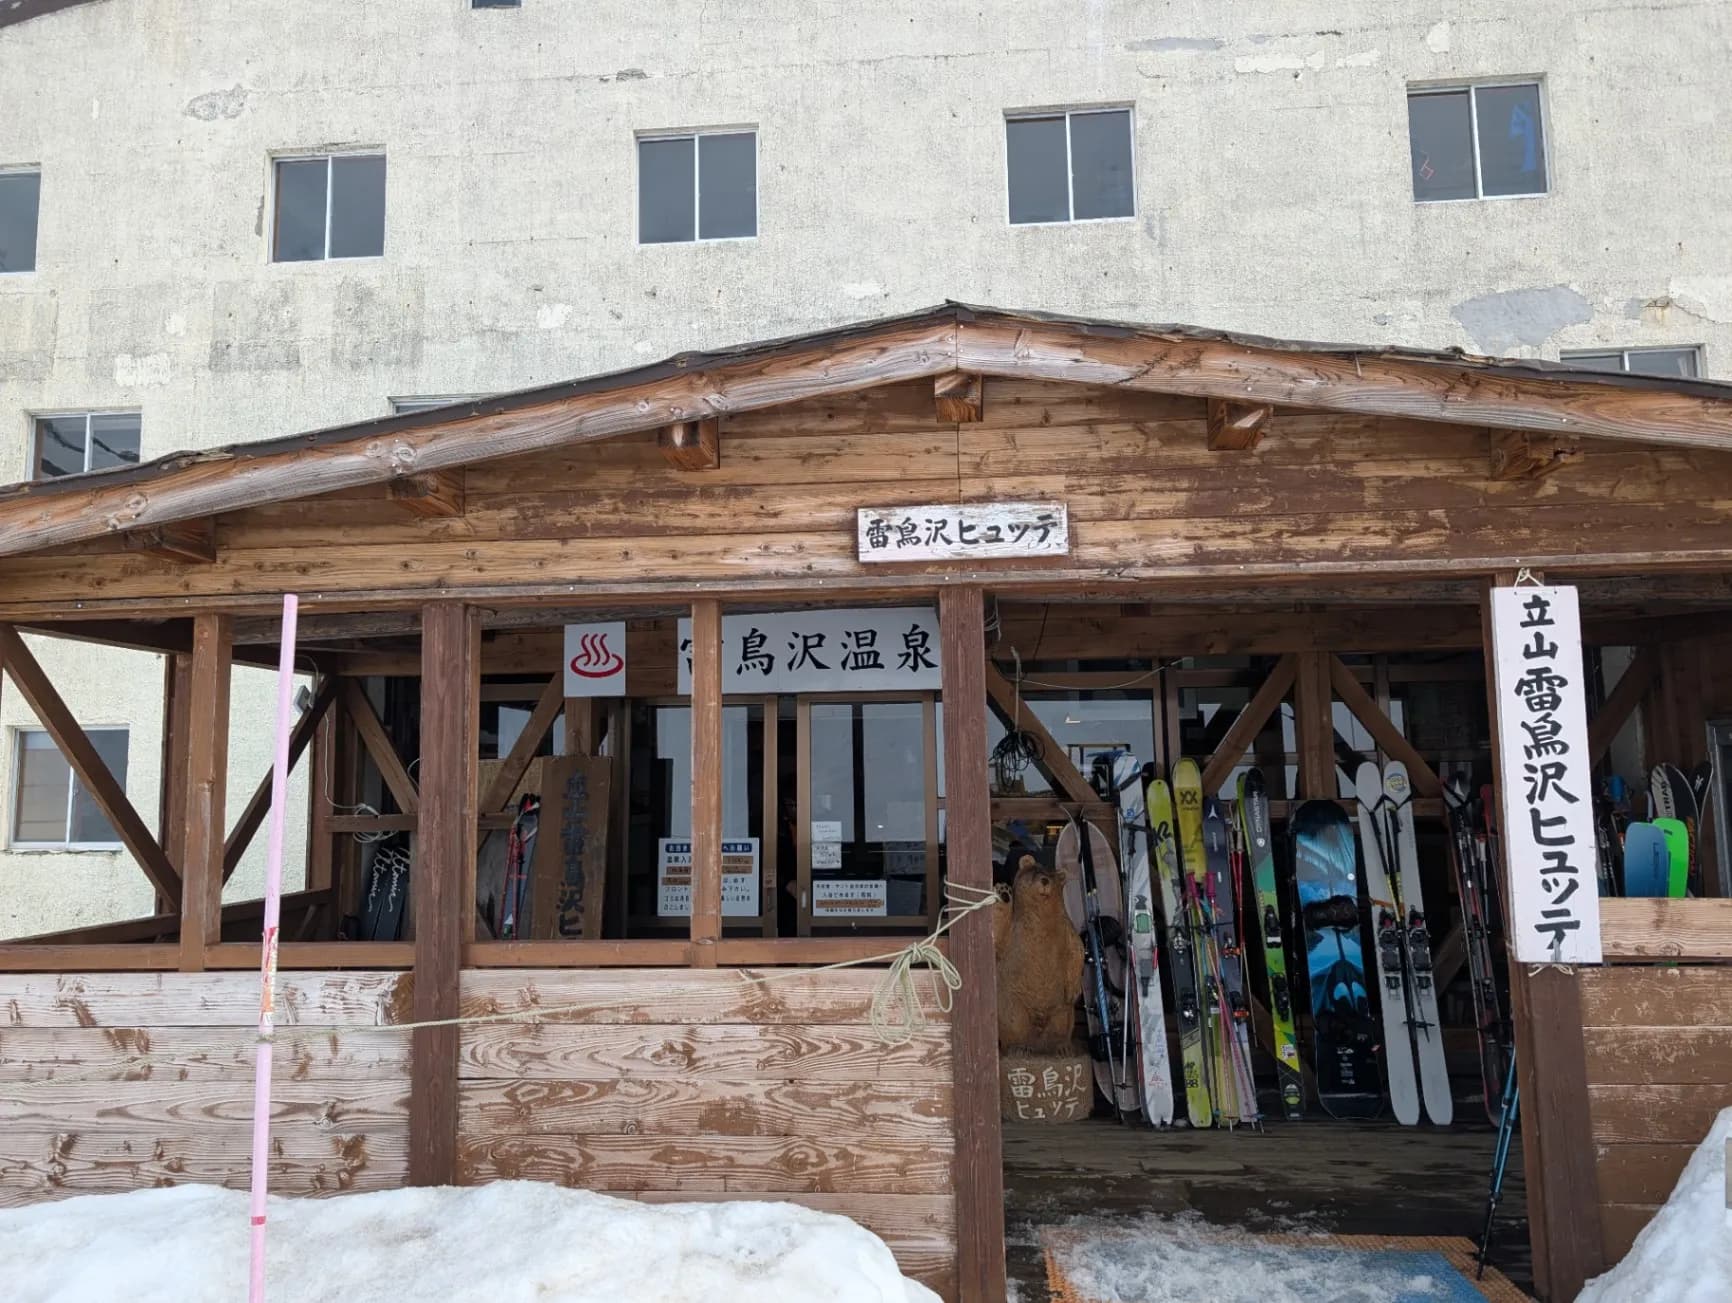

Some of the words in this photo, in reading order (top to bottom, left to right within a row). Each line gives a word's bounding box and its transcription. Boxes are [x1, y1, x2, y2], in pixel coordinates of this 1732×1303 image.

[680, 622, 939, 676] 鳥沢温泉
[1007, 1063, 1088, 1098] 雷鳥沢
